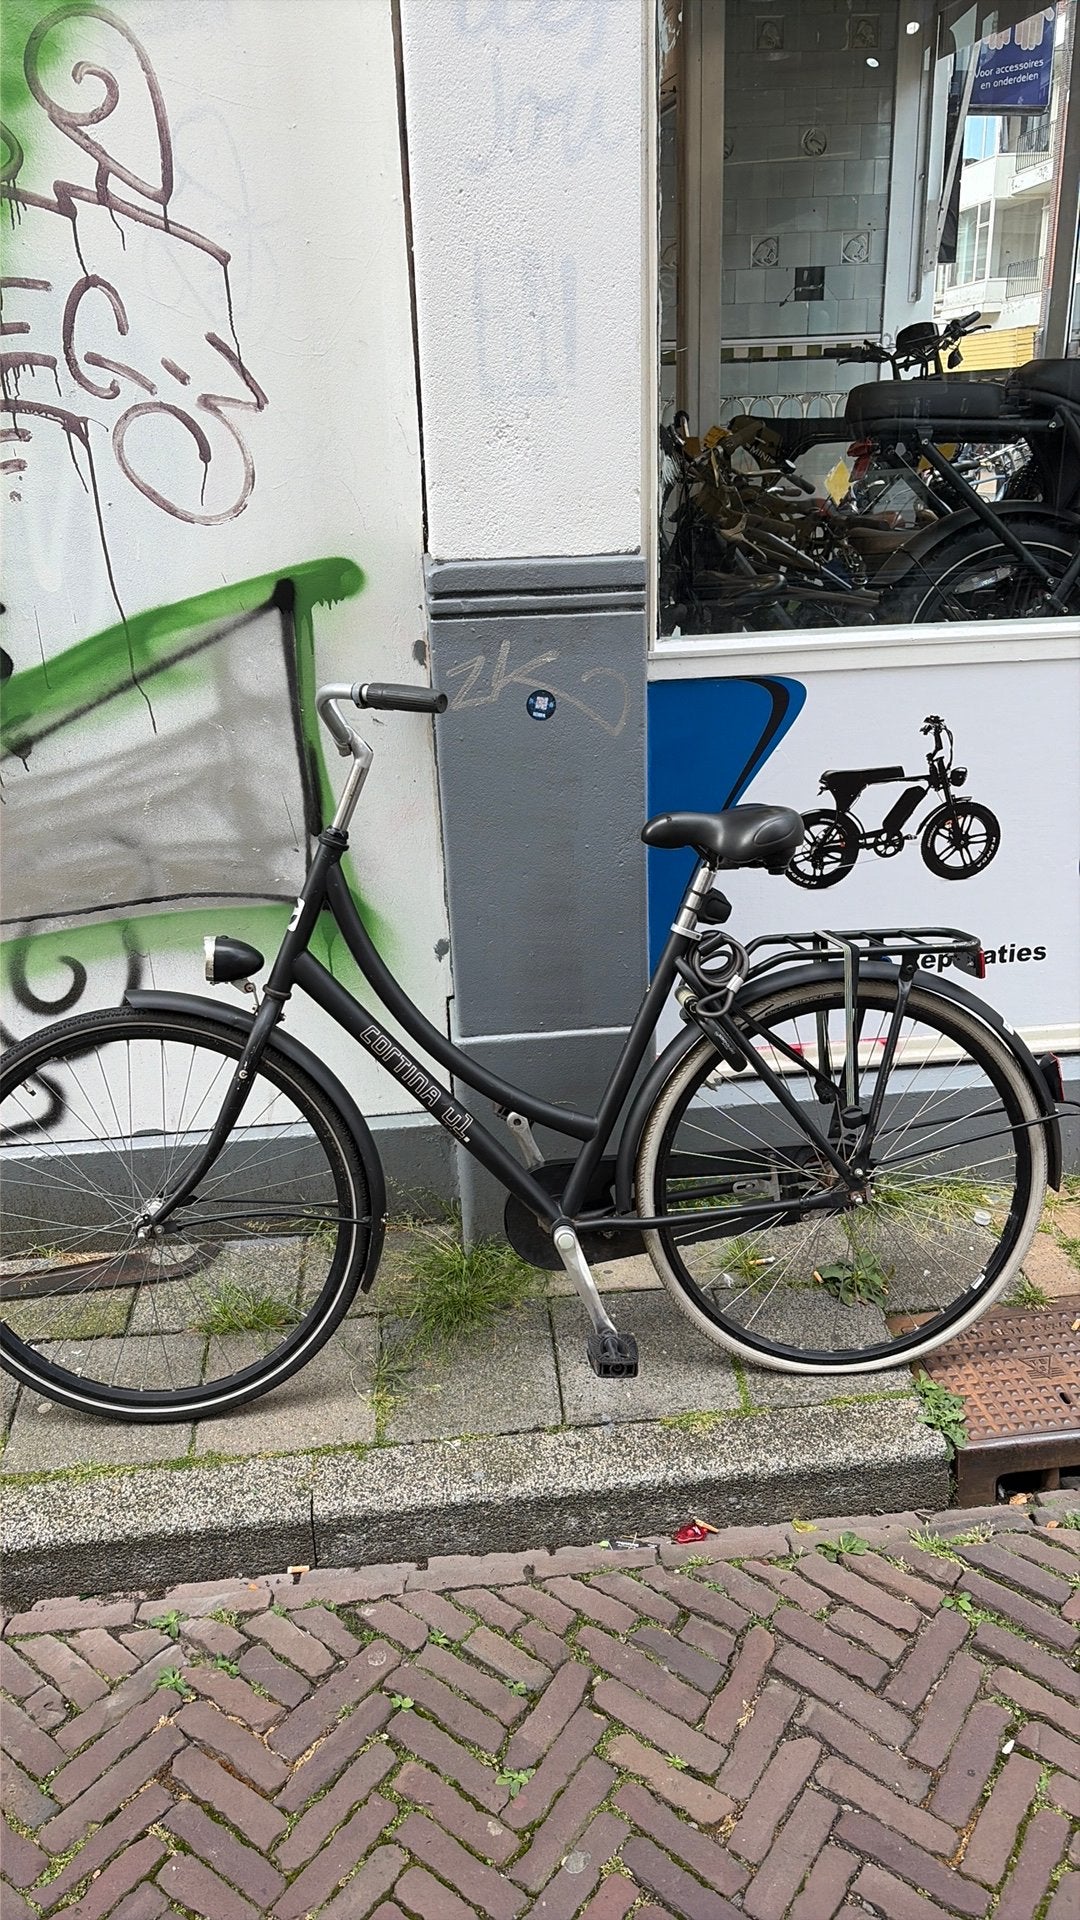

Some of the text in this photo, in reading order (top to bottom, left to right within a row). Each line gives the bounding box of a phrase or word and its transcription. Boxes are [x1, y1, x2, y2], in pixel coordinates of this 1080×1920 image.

[995, 59, 1044, 74] accessoires
[980, 72, 1039, 90] en onderdelen
[919, 944, 1047, 972] epaties
